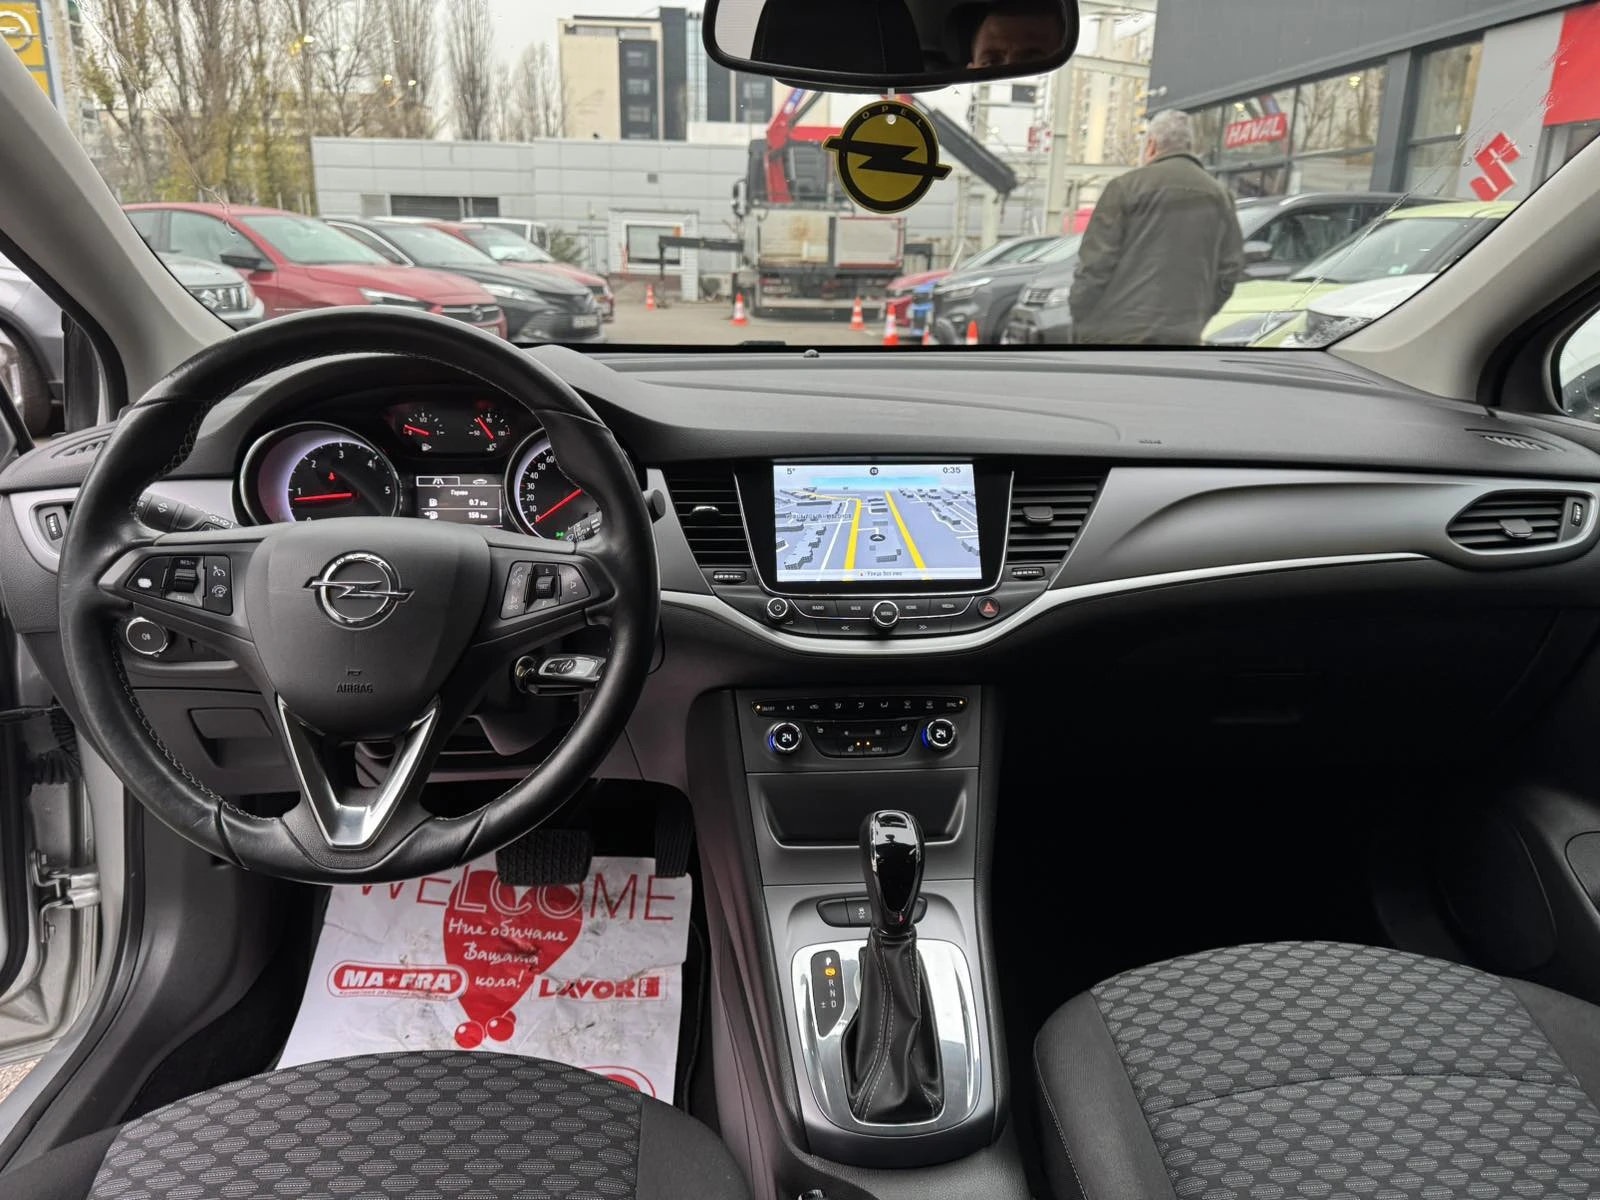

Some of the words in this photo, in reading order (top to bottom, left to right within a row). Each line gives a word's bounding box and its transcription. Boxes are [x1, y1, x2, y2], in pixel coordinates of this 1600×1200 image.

[862, 105, 922, 127] OPEL
[1227, 115, 1282, 145] HAVAL
[339, 450, 344, 459] 3
[546, 455, 555, 463] 60
[311, 459, 317, 468] 2
[367, 460, 374, 468] 4
[537, 462, 546, 471] 50
[787, 467, 796, 475] 5°
[943, 466, 961, 474] 0:35
[530, 471, 539, 480] 40
[297, 487, 302, 495] 1
[336, 683, 374, 694] AIRBAG
[781, 732, 792, 743] 24
[935, 728, 947, 739] 24
[448, 917, 487, 935] Ние
[491, 919, 568, 941] обичаме
[463, 940, 539, 966] Ващата
[475, 969, 525, 989] кола!
[829, 989, 836, 997] N
